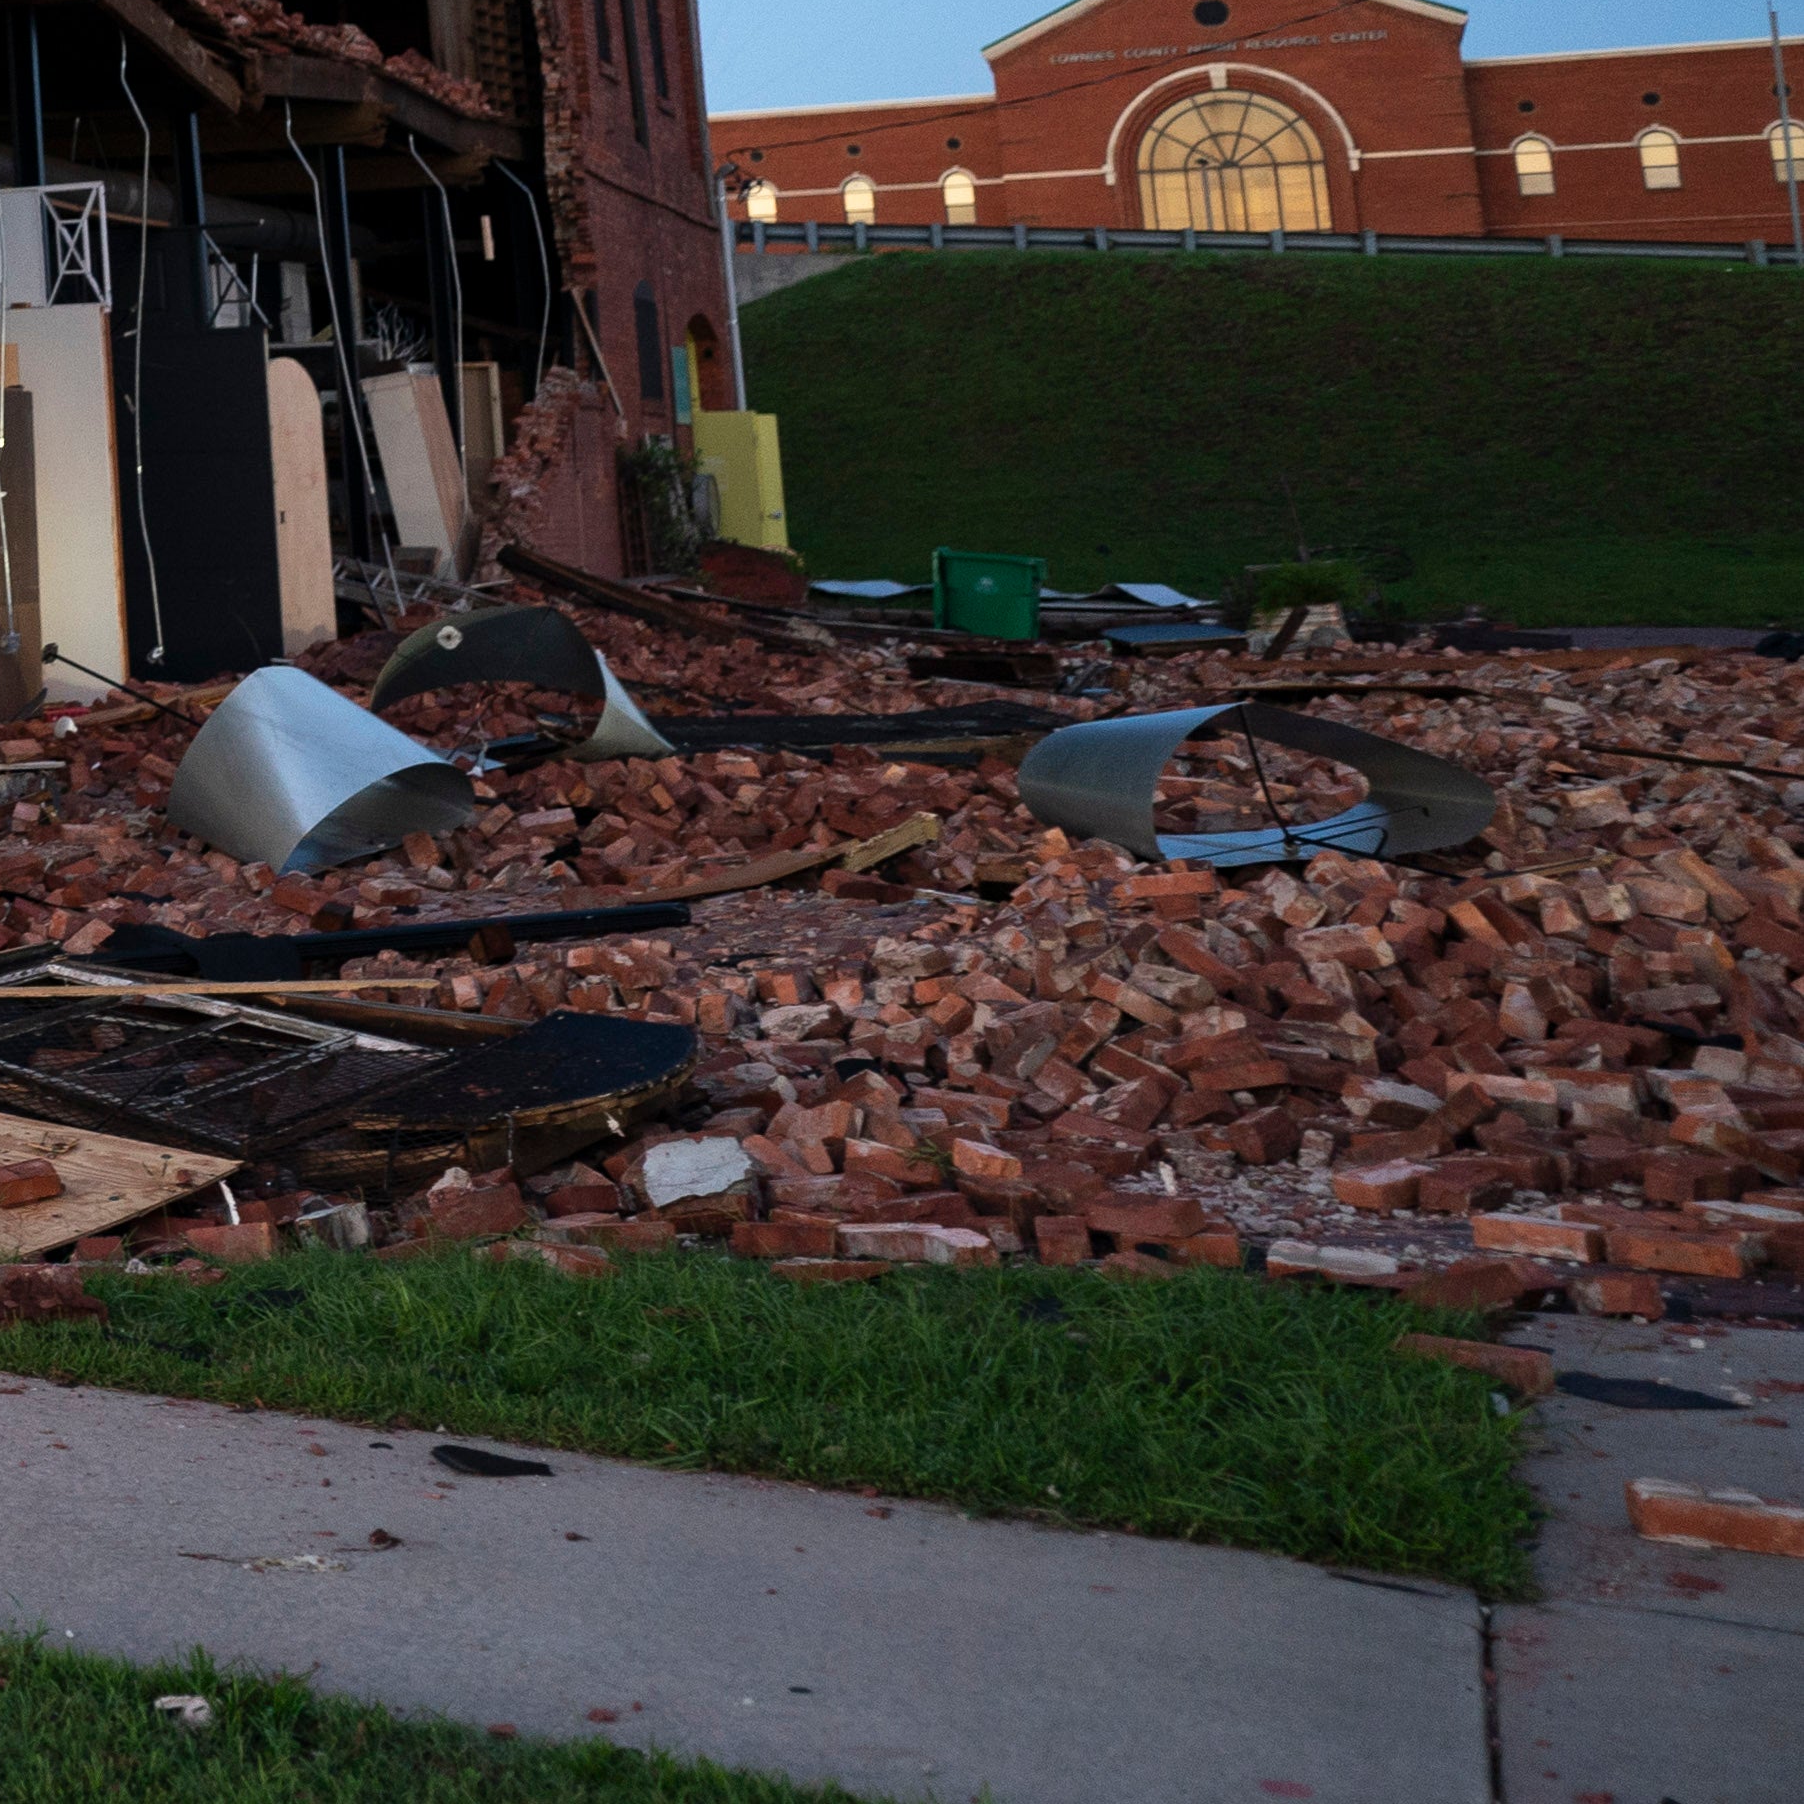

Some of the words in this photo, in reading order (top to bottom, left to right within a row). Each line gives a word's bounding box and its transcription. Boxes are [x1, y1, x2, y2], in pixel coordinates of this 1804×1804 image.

[1050, 50, 1116, 65] LOWNDES
[1123, 47, 1178, 60] COUNTY
[1245, 35, 1320, 50] RESOURCE
[1329, 29, 1388, 44] CENTER
